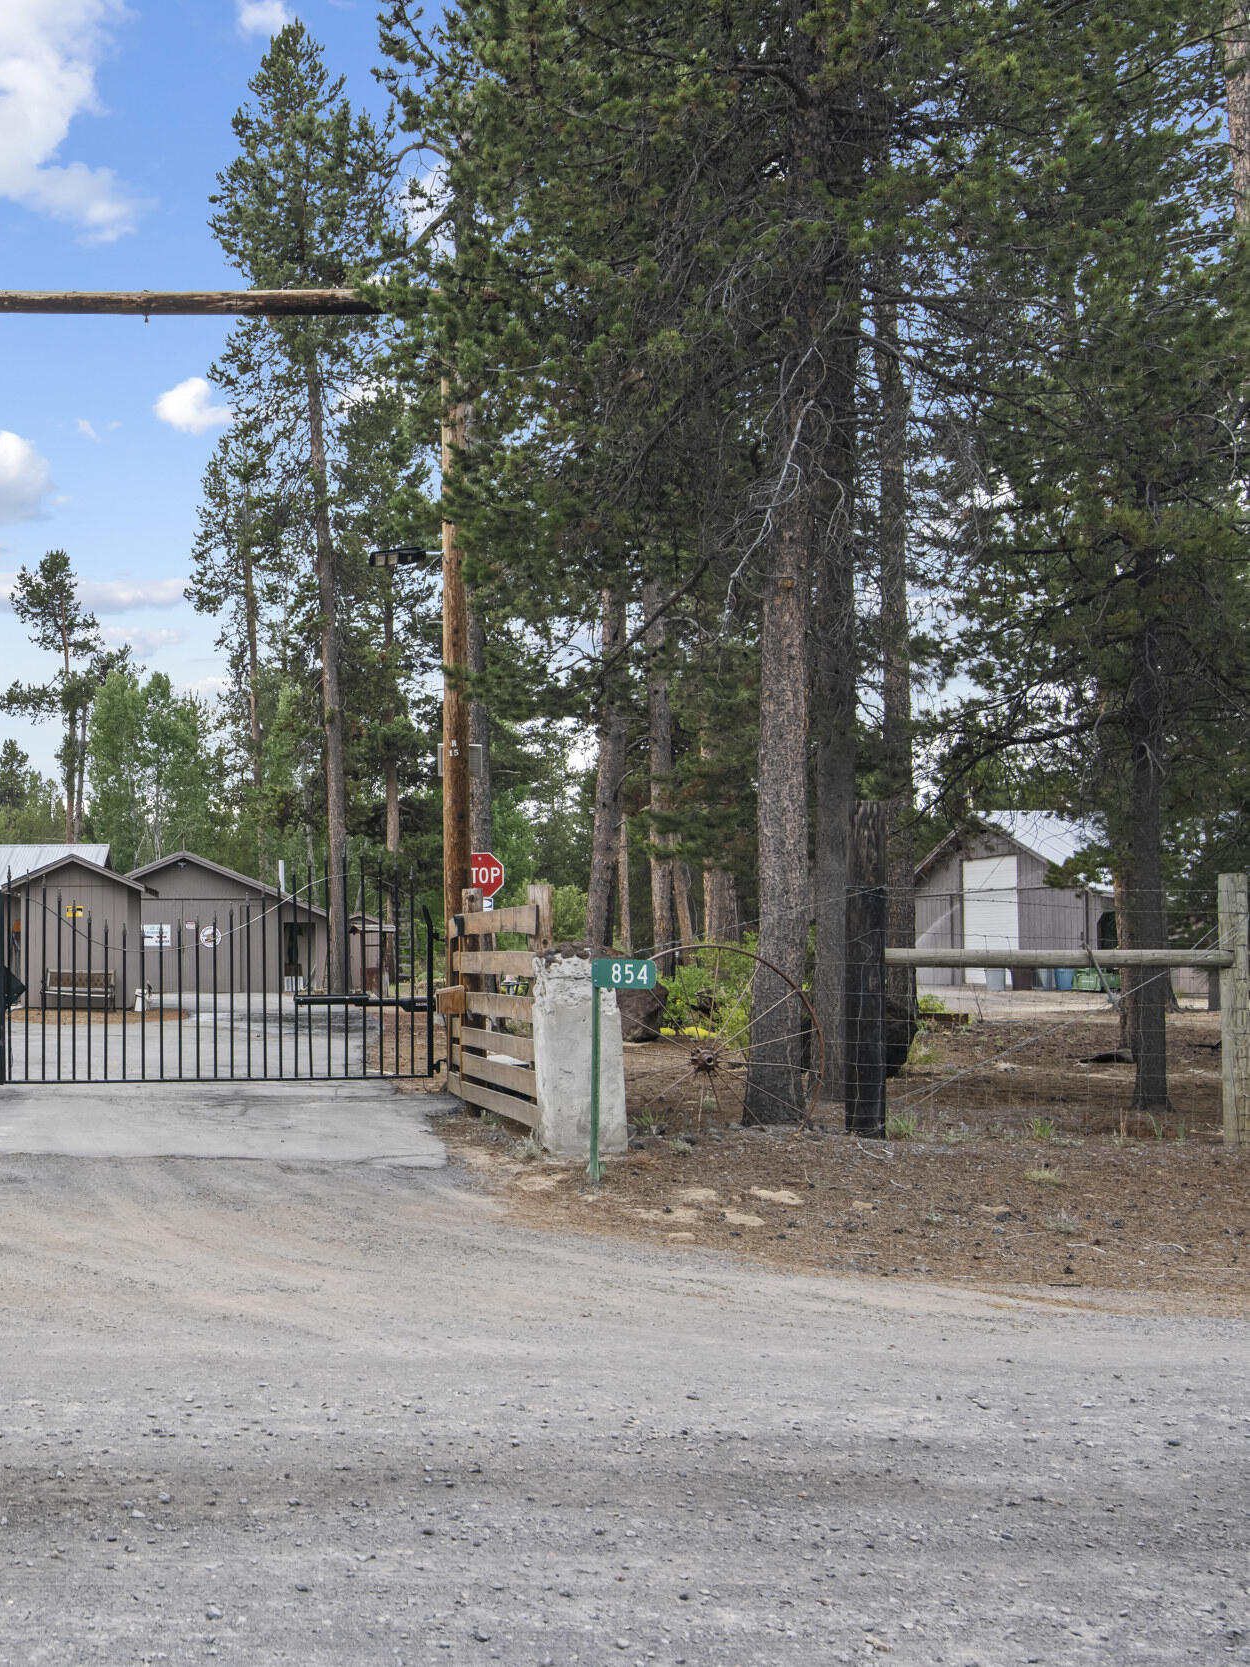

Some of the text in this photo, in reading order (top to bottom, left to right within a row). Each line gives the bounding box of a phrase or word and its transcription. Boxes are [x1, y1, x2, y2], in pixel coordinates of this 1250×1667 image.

[449, 749, 460, 757] 15
[471, 867, 501, 884] TOP
[611, 962, 649, 985] 854
